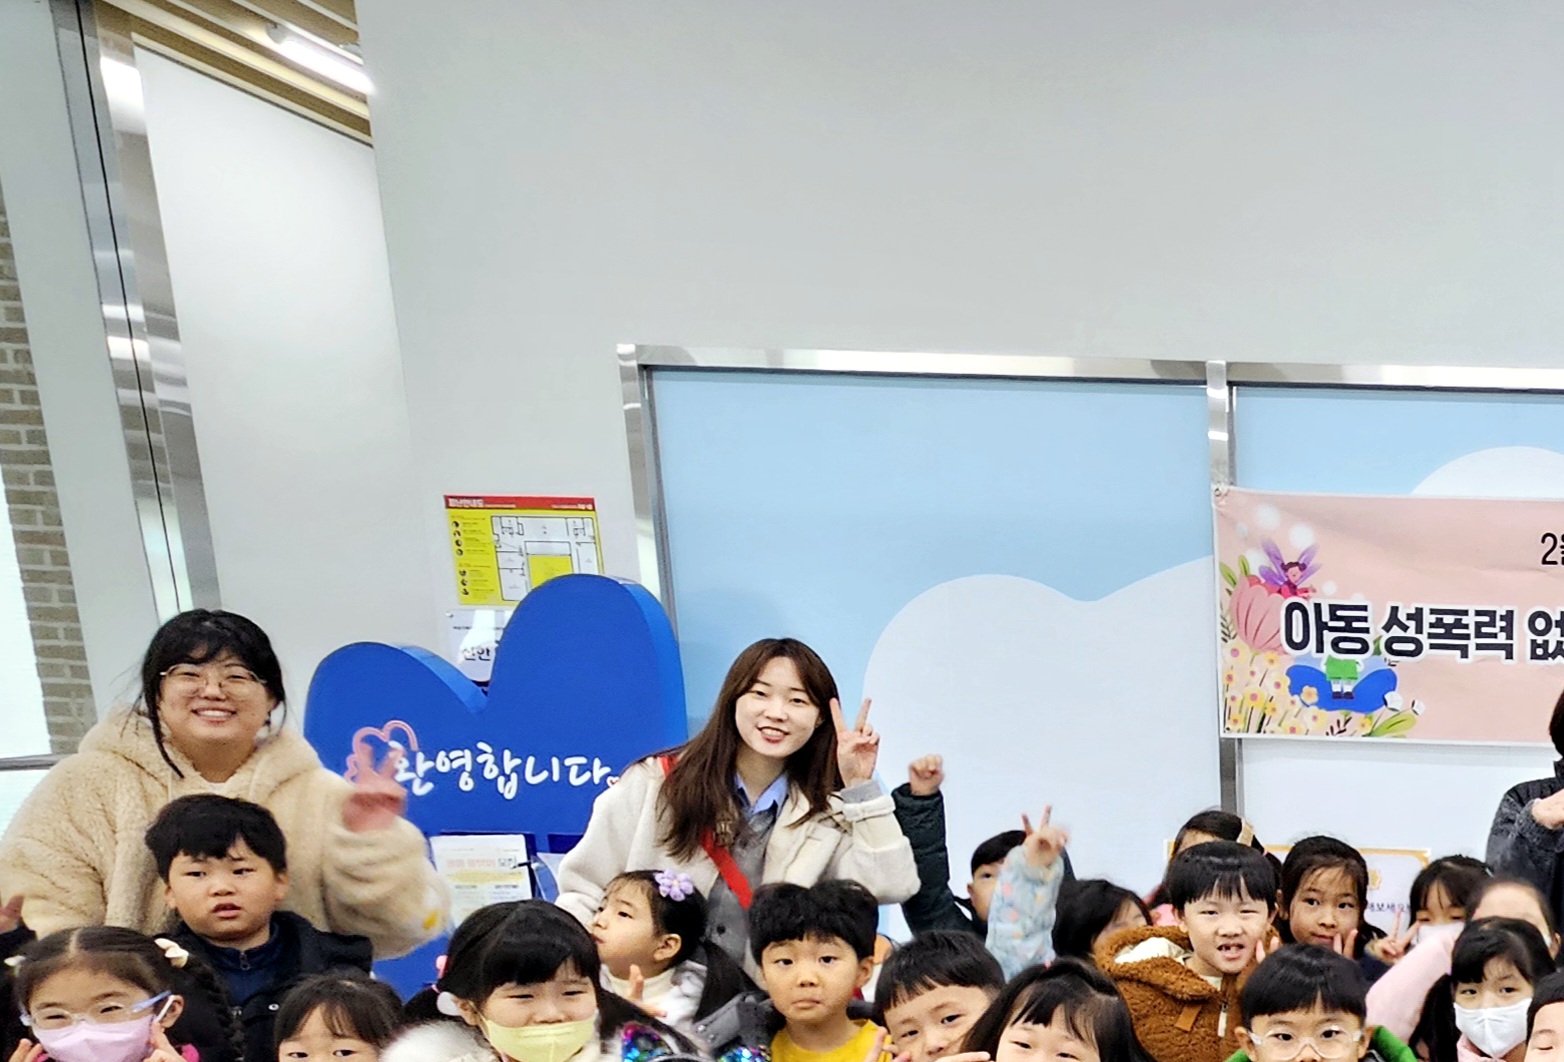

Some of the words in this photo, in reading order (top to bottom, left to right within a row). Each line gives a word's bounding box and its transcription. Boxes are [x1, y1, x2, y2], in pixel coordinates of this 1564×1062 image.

[1284, 600, 1371, 655] 아동
[1382, 604, 1516, 661] 성폭력
[388, 741, 612, 800] 환영합니다
